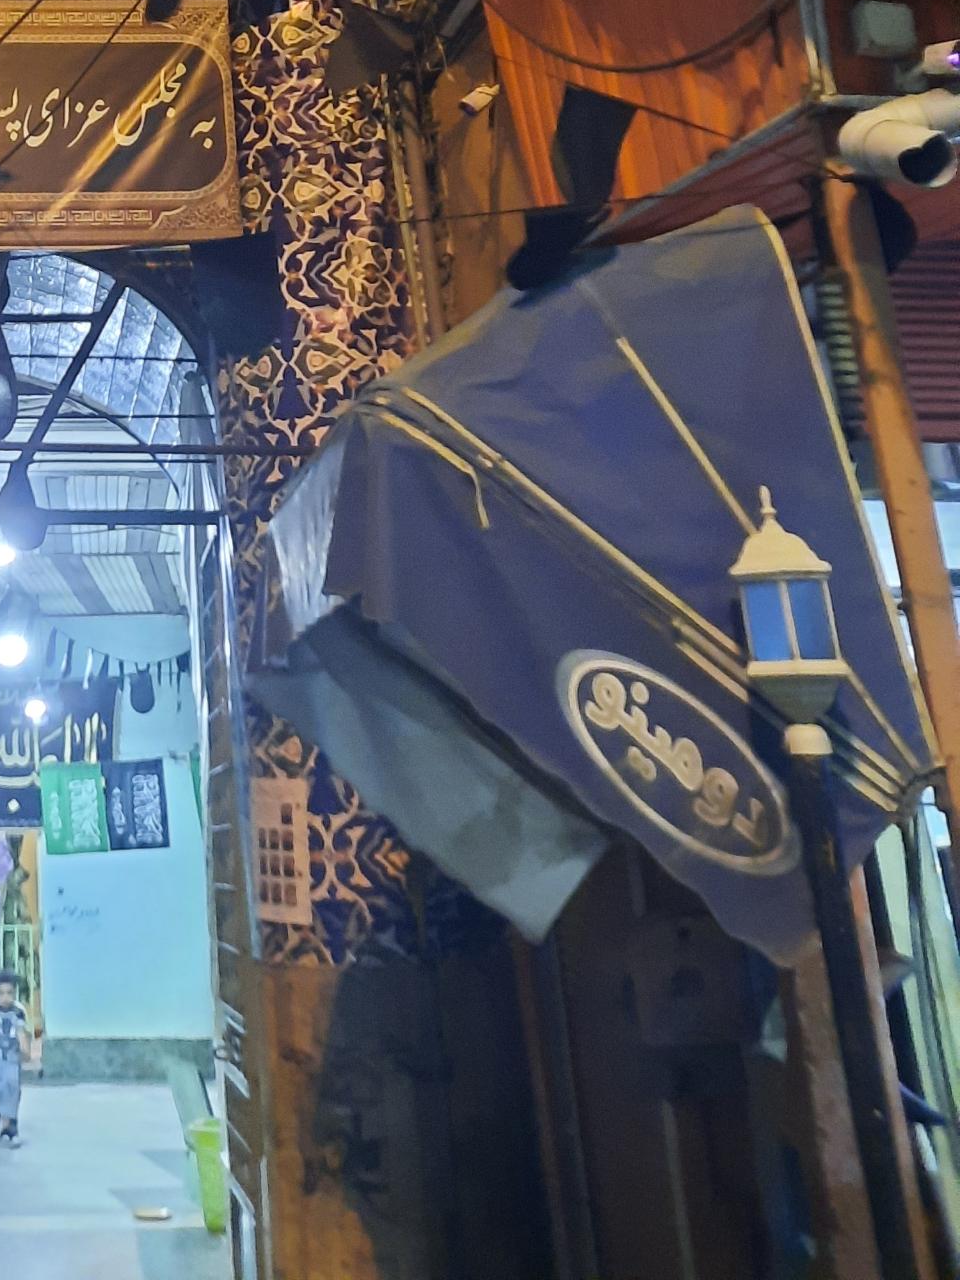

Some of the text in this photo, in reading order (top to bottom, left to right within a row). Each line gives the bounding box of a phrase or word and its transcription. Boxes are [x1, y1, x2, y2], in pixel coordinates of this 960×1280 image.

[23, 87, 110, 148] عزای
[113, 62, 187, 147] مجلس
[191, 116, 216, 149] به
[585, 672, 767, 849] دومینو
